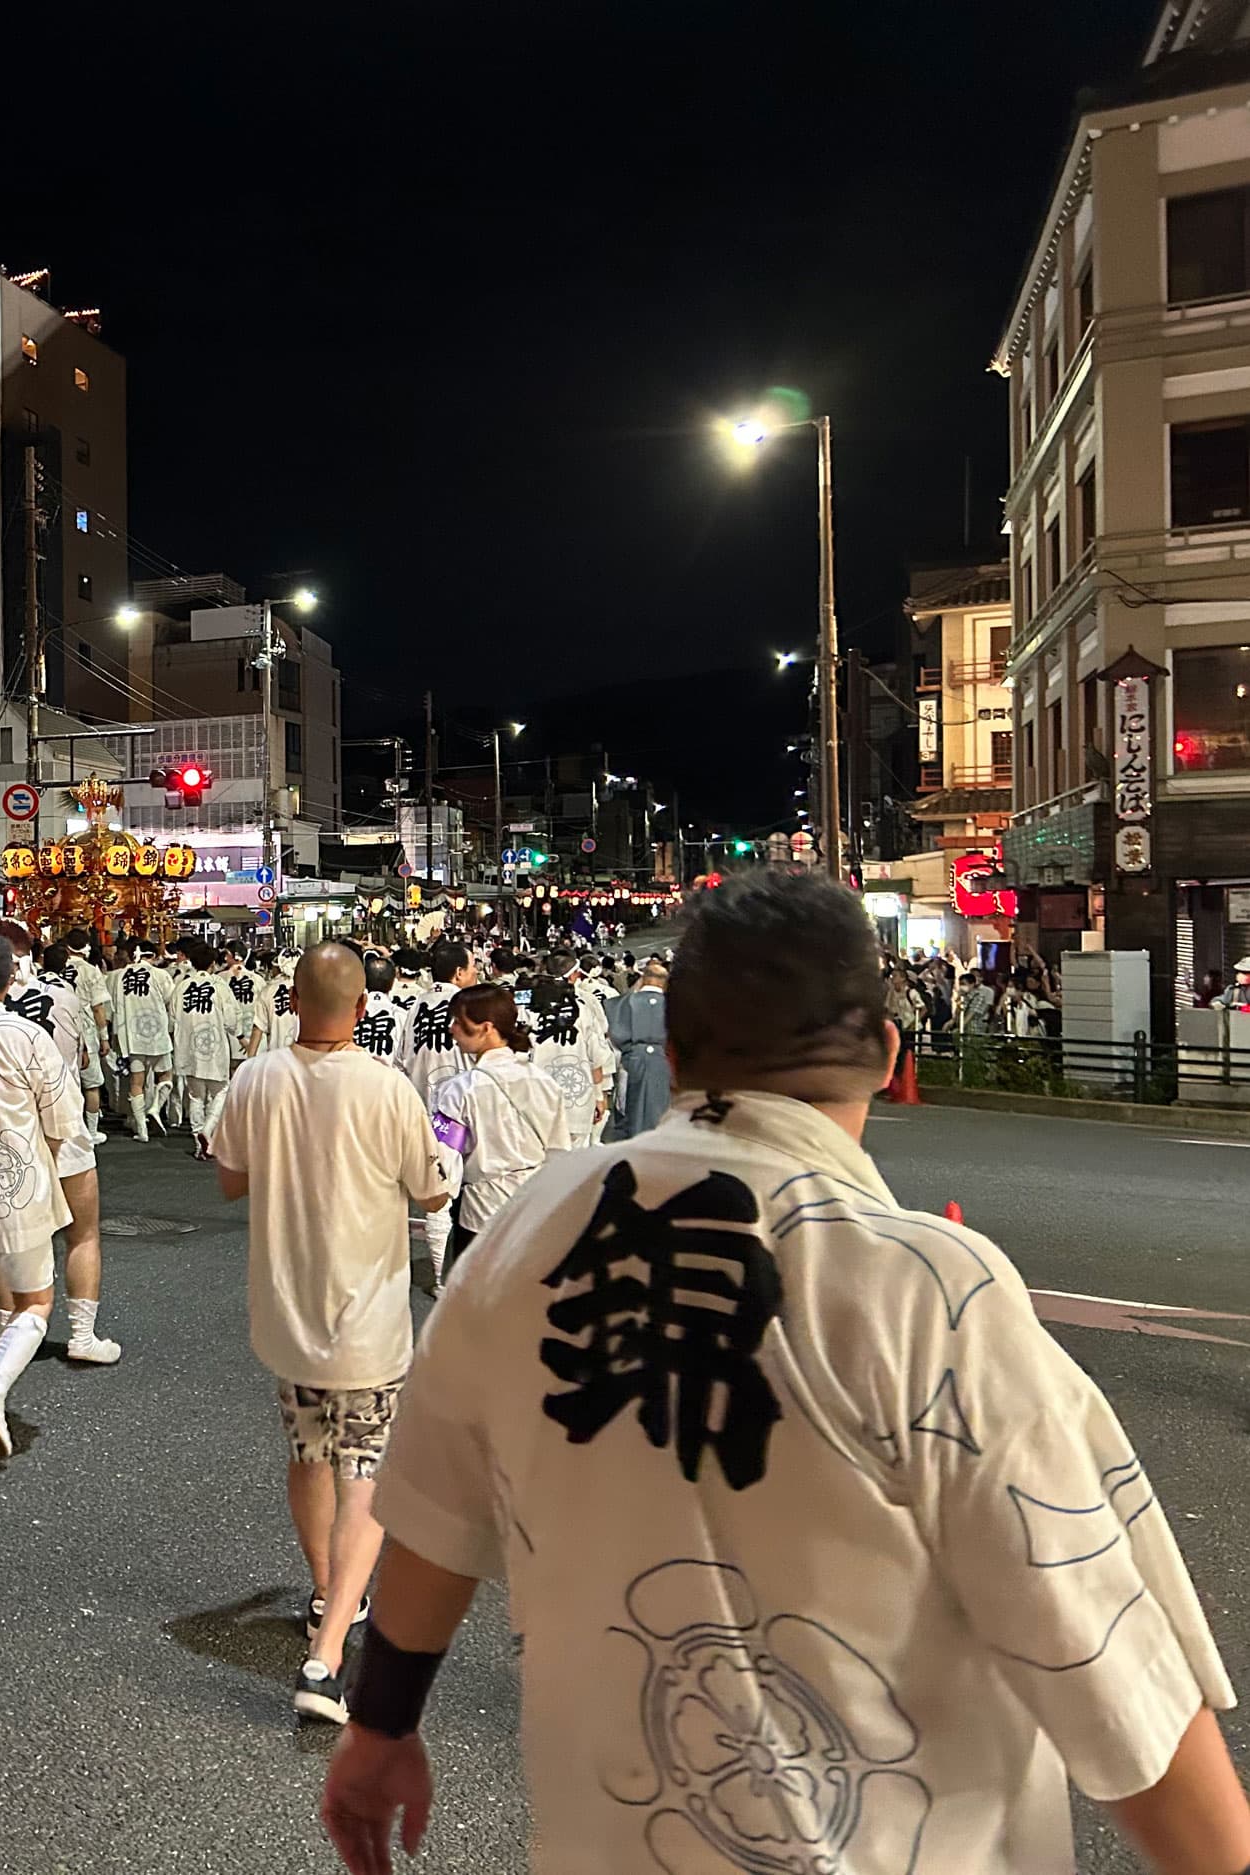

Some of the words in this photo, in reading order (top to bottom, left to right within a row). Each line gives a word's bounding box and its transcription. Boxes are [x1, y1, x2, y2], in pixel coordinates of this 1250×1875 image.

[1118, 714, 1147, 813] にしんそば
[113, 851, 128, 869] 錦
[143, 849, 158, 866] 錦
[122, 968, 151, 997] 錦
[183, 982, 215, 1014] 錦
[229, 976, 254, 1006] 錦
[353, 1009, 397, 1056] 錦
[412, 1000, 458, 1055] 錦
[540, 1159, 783, 1491] 錦
